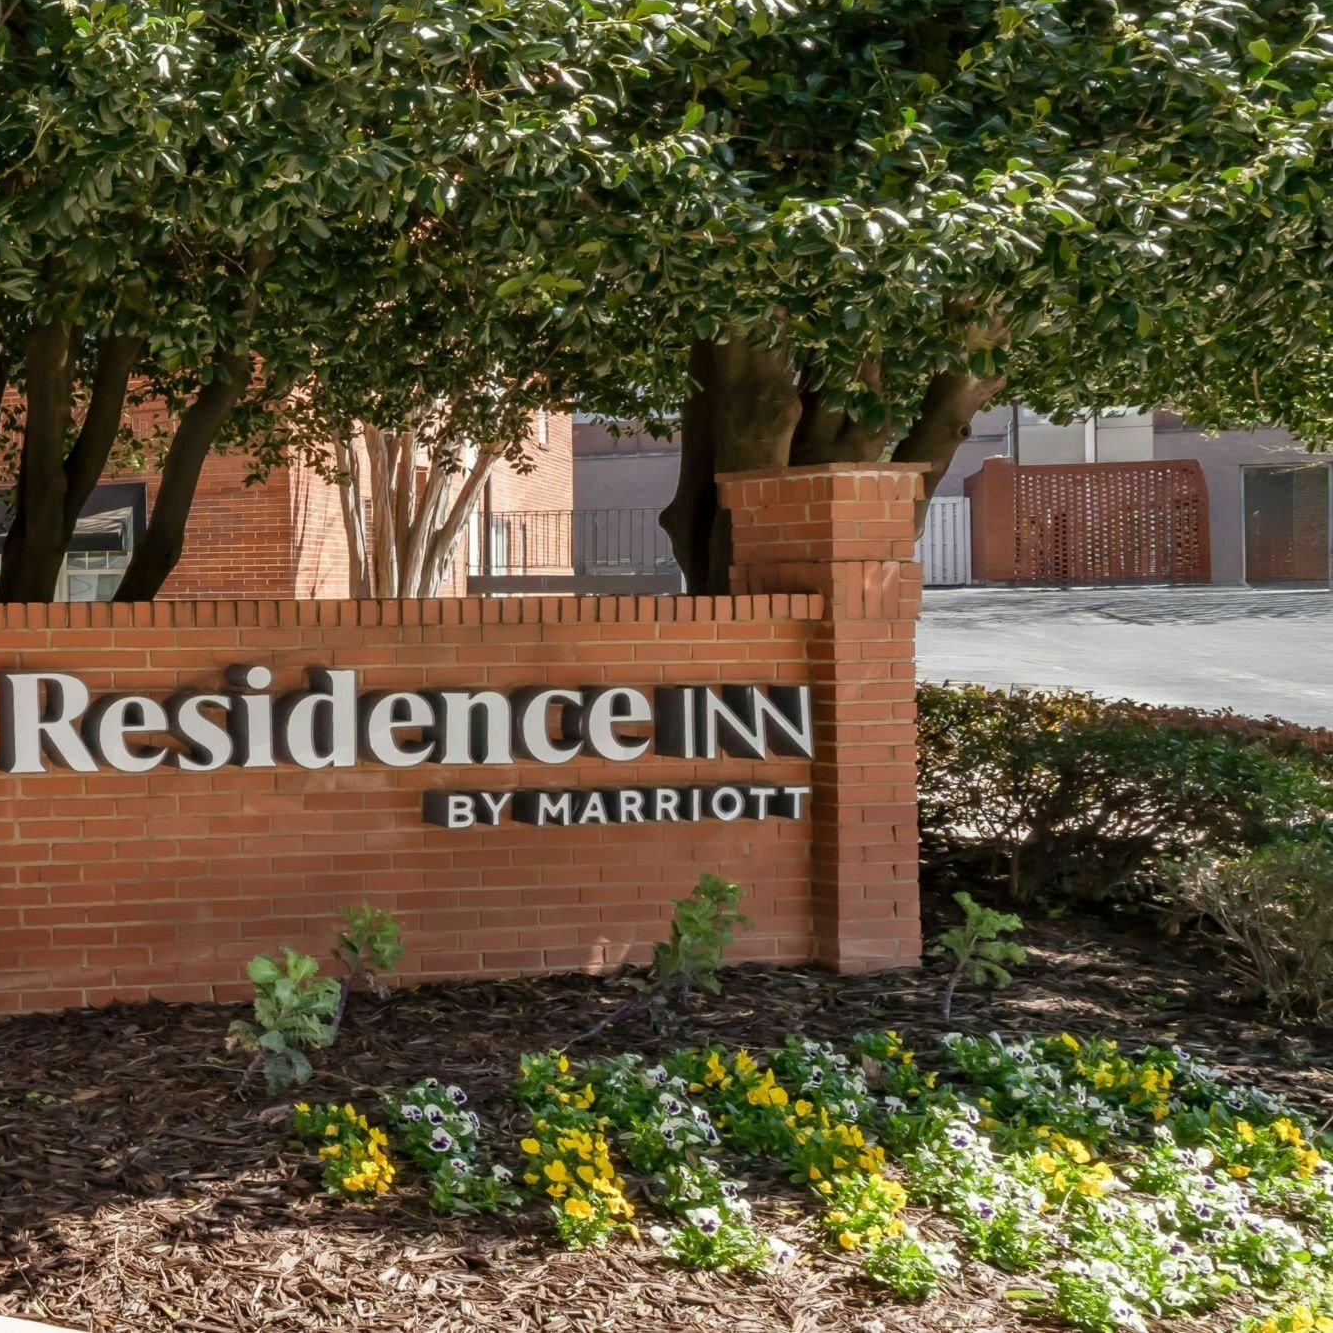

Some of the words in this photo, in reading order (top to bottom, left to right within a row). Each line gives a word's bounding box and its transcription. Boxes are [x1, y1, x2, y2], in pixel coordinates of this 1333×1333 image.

[1, 665, 653, 774] Residence
[679, 685, 814, 762] INN
[446, 792, 513, 829] BY
[536, 785, 812, 827] MARRIOTT
